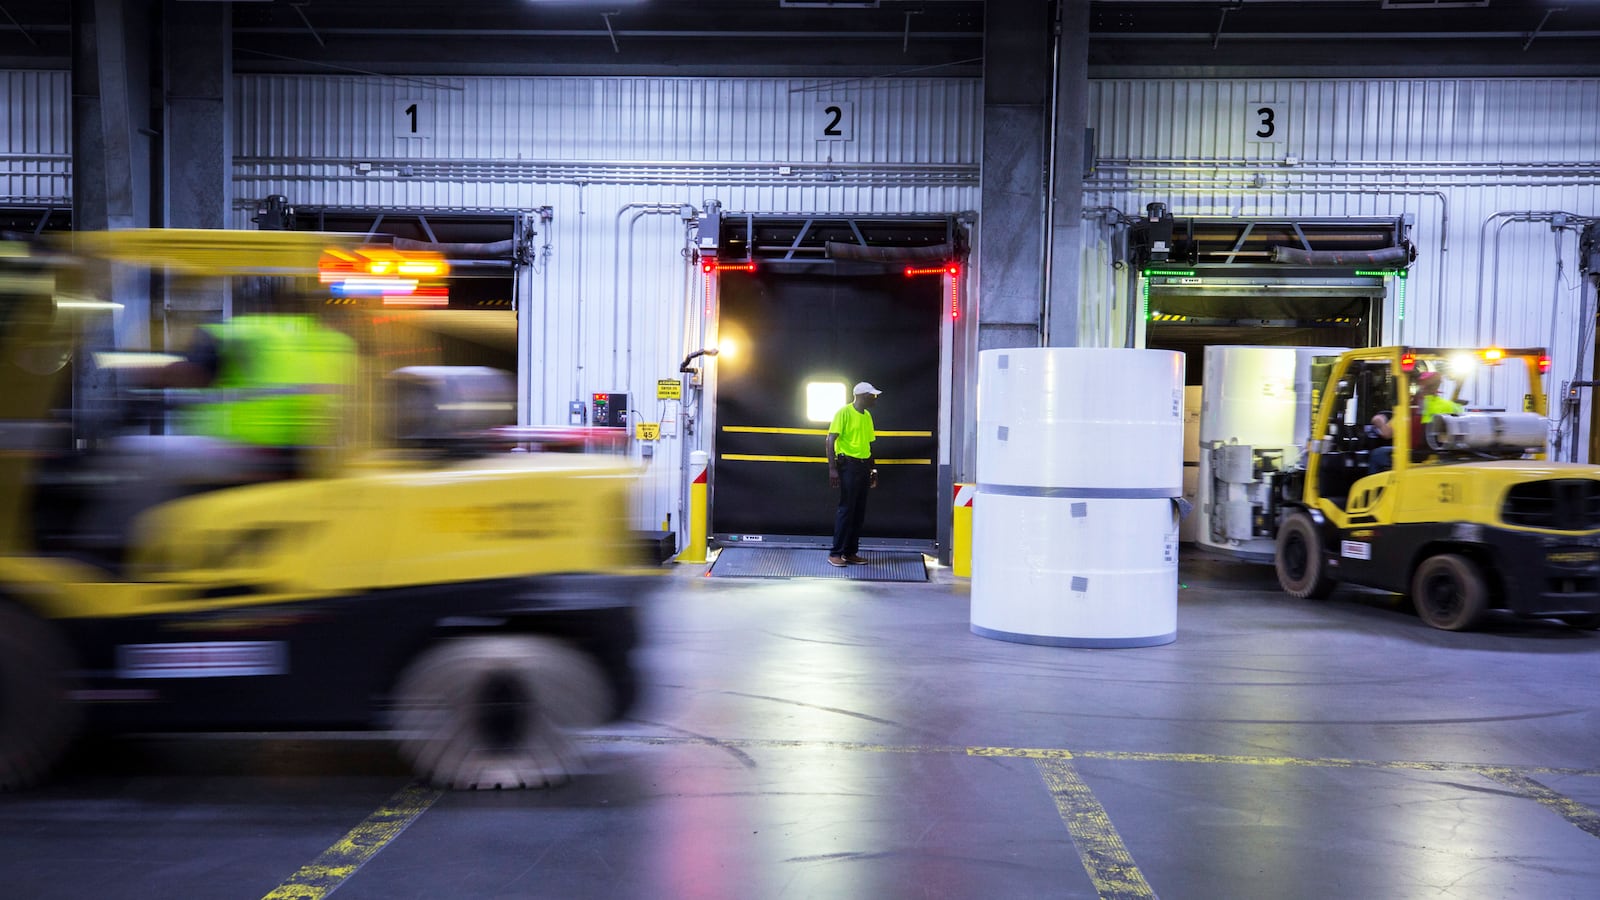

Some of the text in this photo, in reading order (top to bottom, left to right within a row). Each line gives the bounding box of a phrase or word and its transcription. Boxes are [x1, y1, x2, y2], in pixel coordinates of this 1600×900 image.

[405, 103, 418, 133] 1
[823, 105, 842, 136] 2
[1256, 107, 1275, 138] 3
[643, 431, 653, 439] 45
